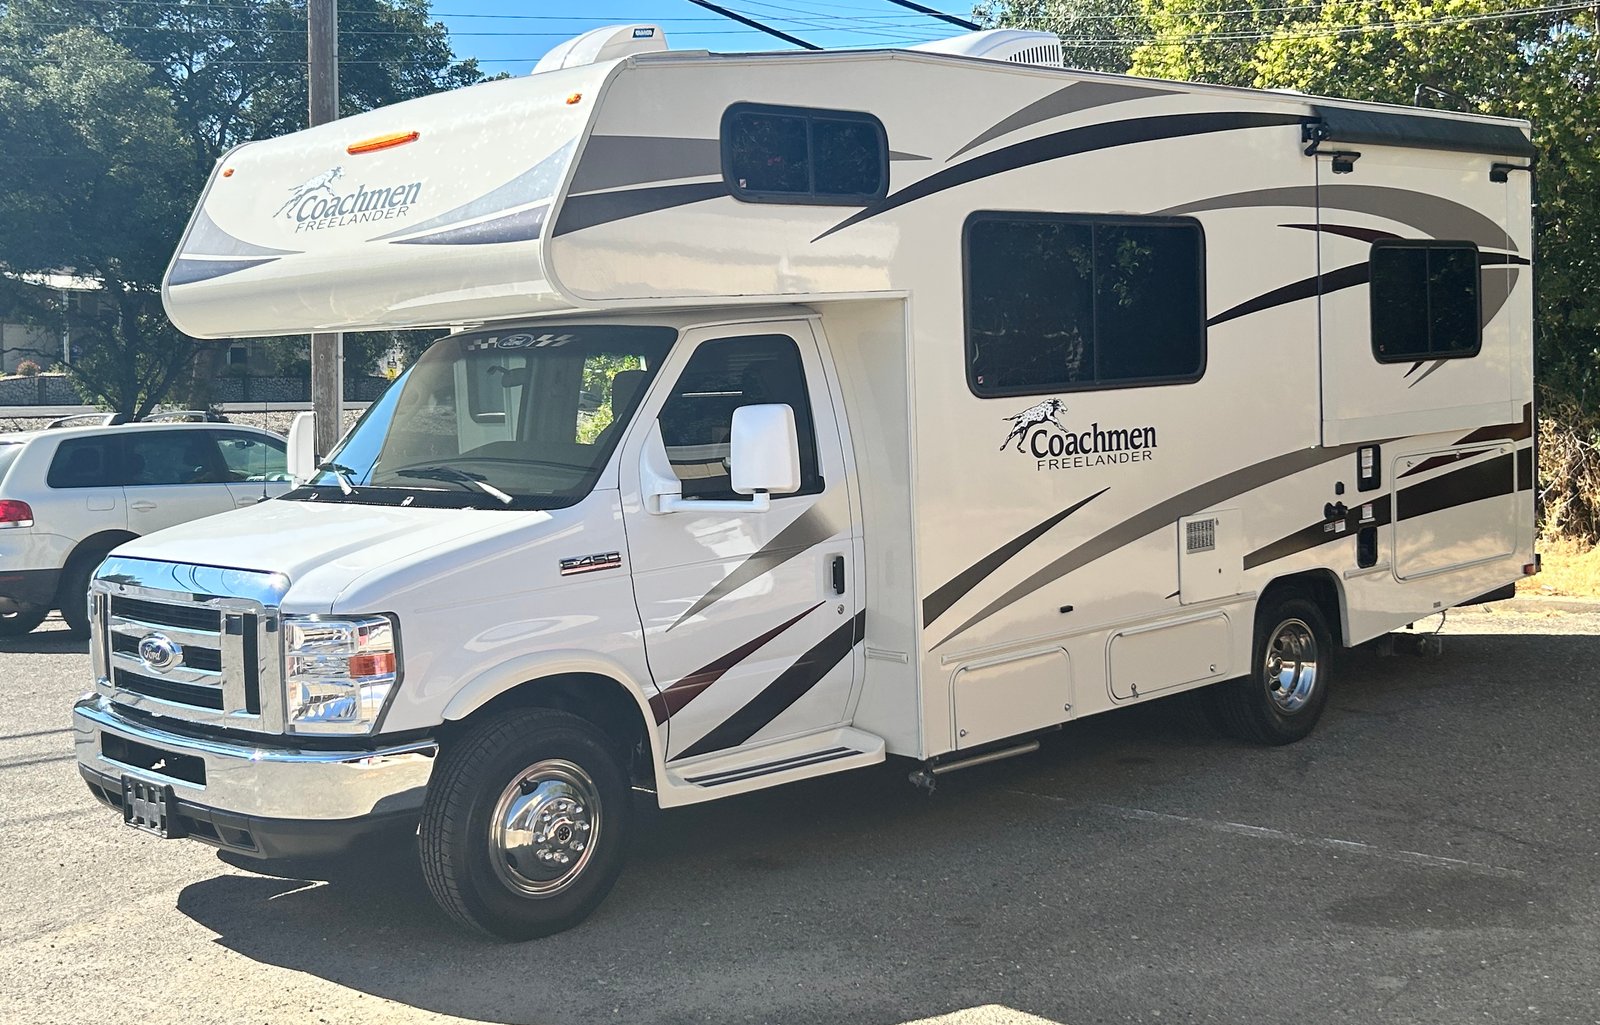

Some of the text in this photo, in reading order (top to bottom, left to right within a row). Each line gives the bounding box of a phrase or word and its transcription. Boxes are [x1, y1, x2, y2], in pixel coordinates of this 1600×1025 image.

[296, 182, 422, 223] Coachmen
[295, 205, 409, 233] FREELANDER
[1030, 423, 1157, 459] Coachmen
[1037, 450, 1153, 471] FREELANDER
